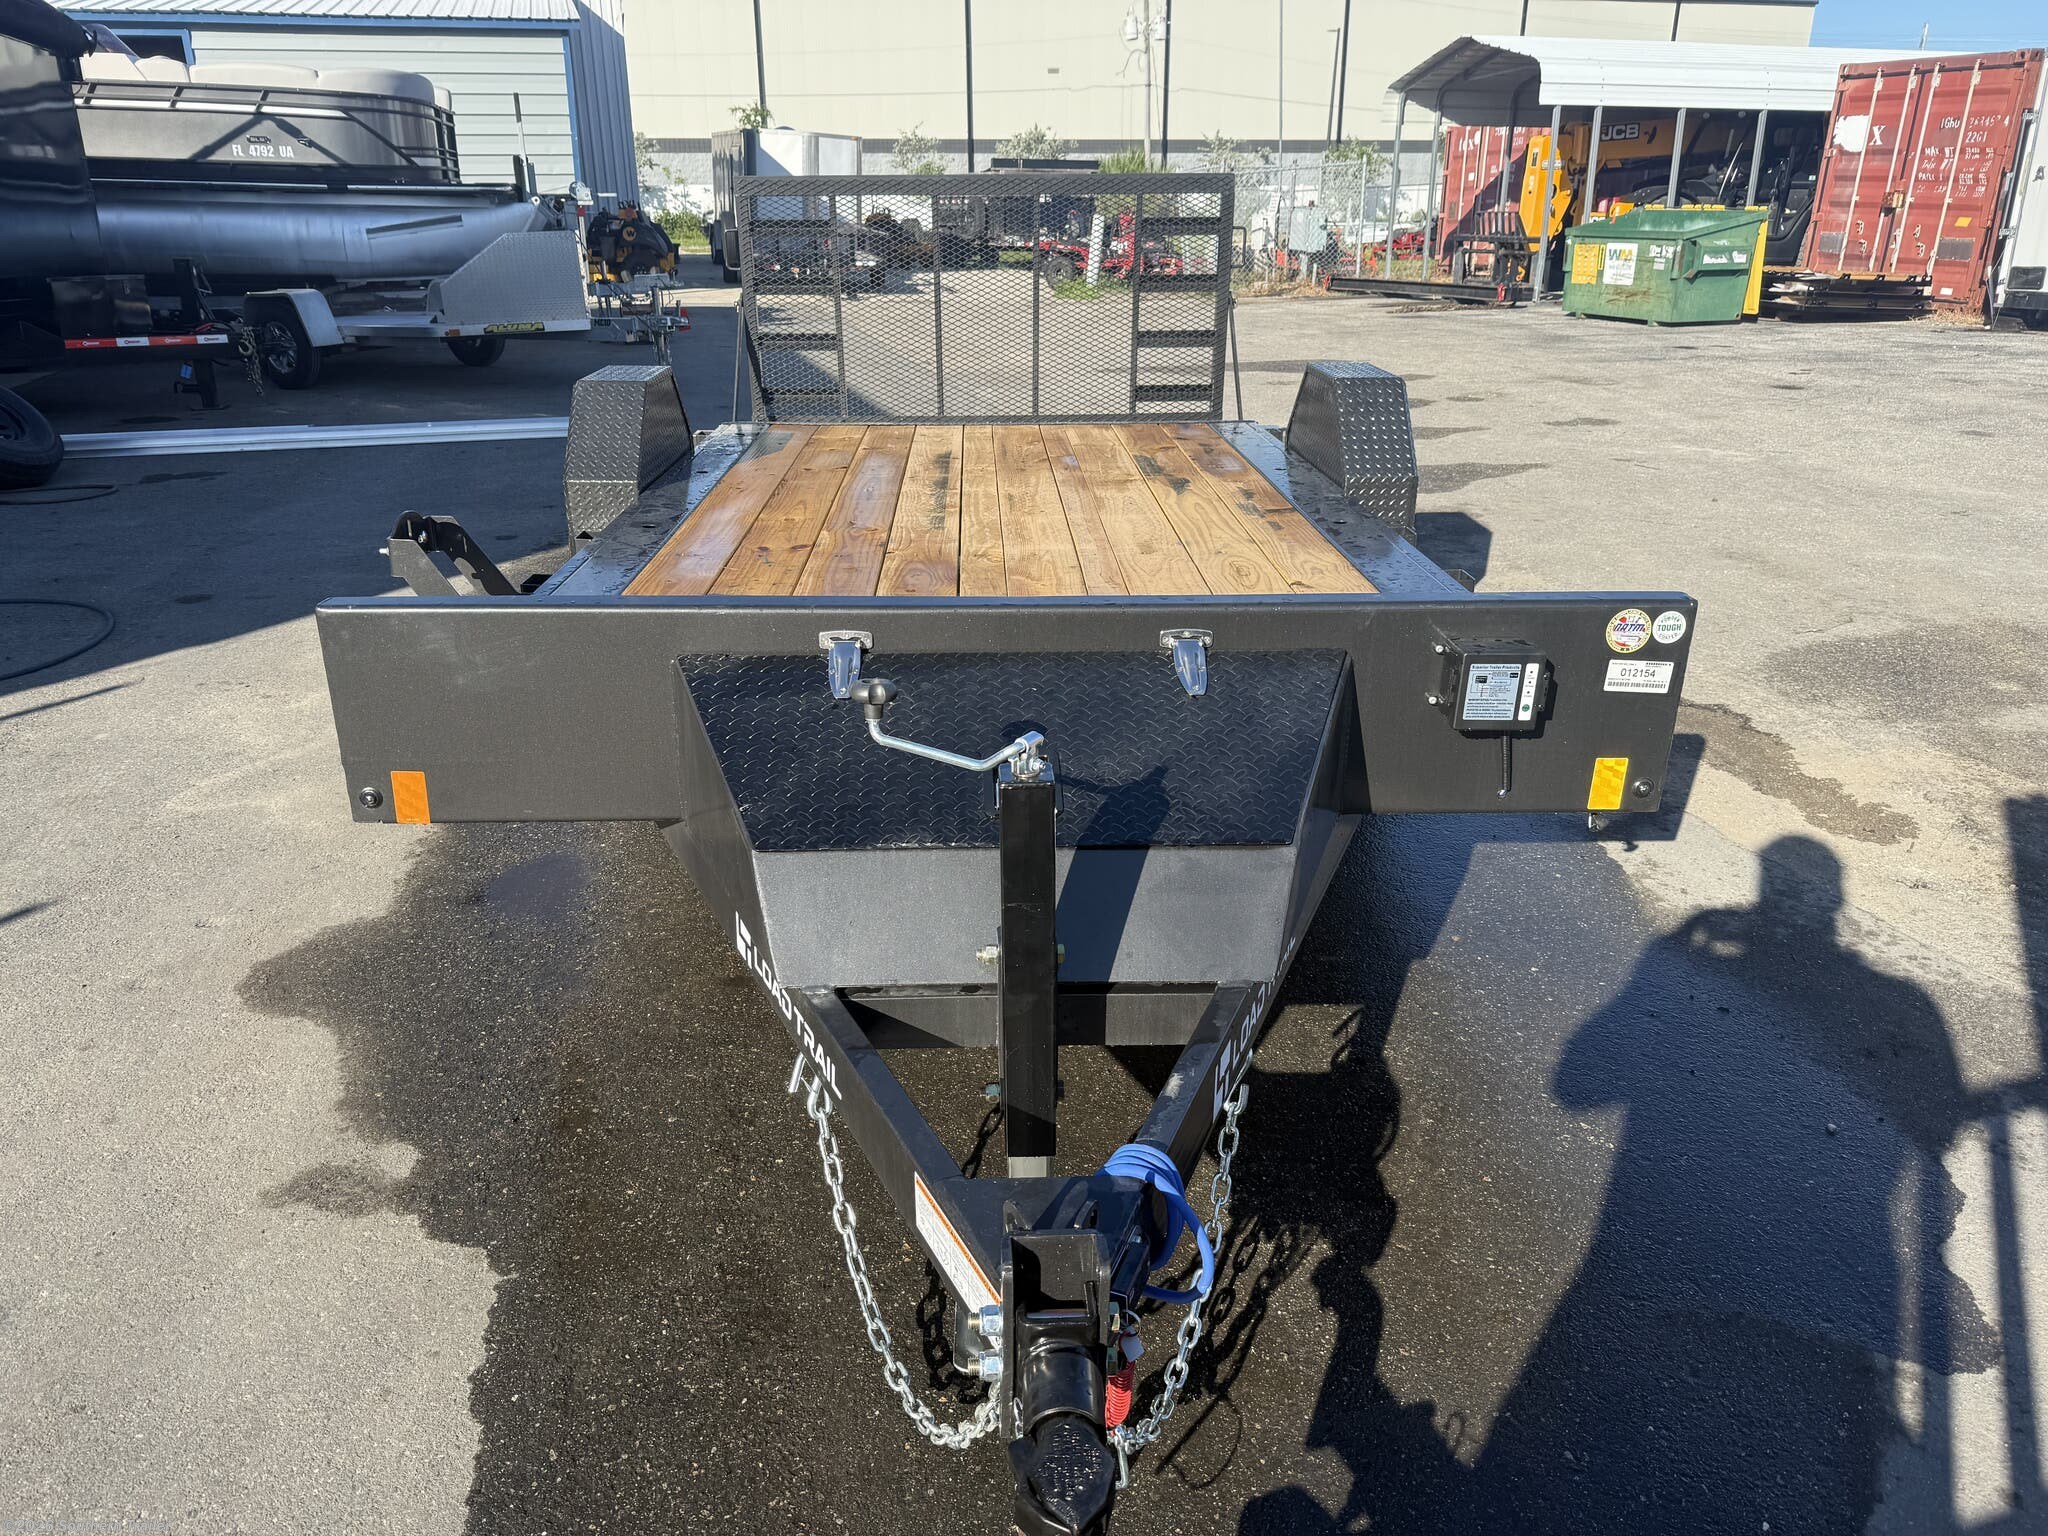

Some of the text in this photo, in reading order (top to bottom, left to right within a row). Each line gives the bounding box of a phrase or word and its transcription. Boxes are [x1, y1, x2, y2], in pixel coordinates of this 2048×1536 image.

[1601, 125, 1639, 140] JCB
[232, 144, 294, 158] FL 4792 UA
[1608, 249, 1633, 260] WM
[484, 322, 545, 333] ALUMA
[1657, 624, 1682, 632] TOUGH
[1620, 668, 1656, 678] 012154
[754, 946, 842, 1100] LOAD TRAIL
